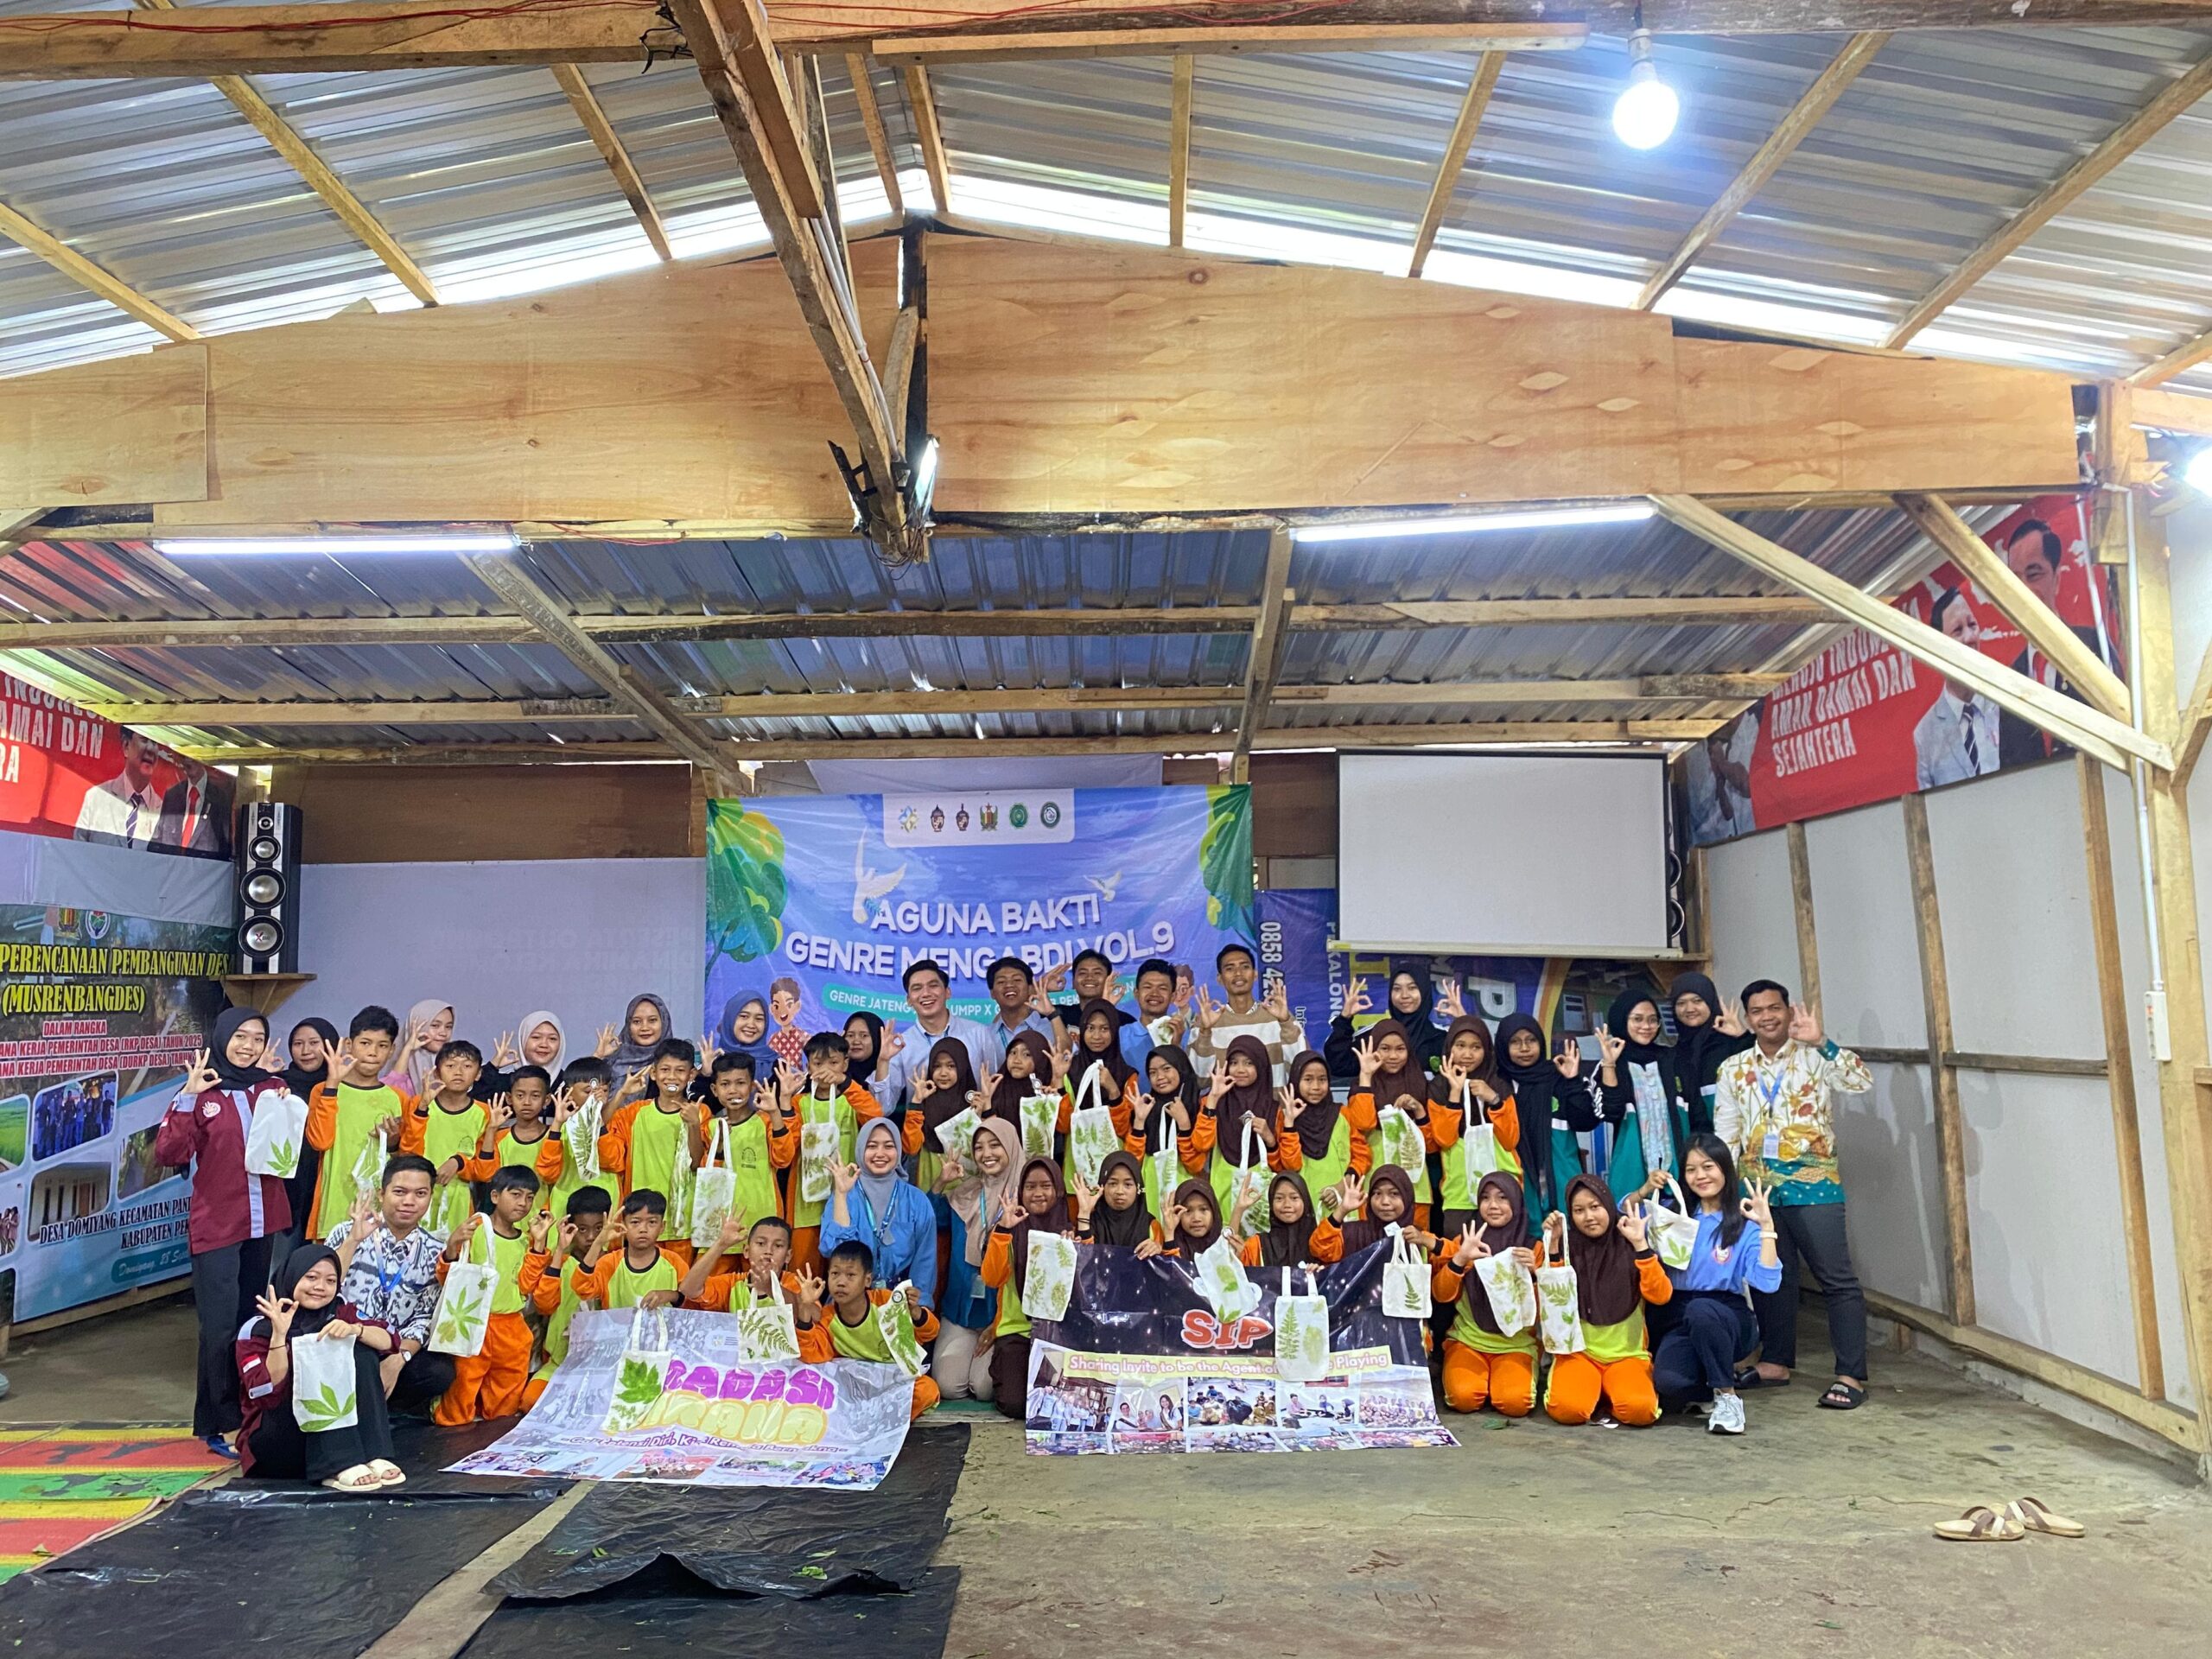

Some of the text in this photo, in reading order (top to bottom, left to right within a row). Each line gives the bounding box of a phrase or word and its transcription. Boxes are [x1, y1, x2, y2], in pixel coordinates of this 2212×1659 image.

[1771, 651, 1916, 740] AMAN DAMAI DAN
[60, 716, 104, 759] DAN
[1772, 718, 1857, 778] SEJAHTERA
[1001, 893, 1101, 933] BAKTI
[0, 944, 109, 976] PERENCANAAN
[112, 948, 206, 977] PEMBANGUNAN
[785, 931, 894, 977] GENRE
[901, 939, 1073, 978] MENGBDI
[1261, 922, 1283, 963] 0858
[3, 984, 146, 1017] (MUSRENBANGDES)
[830, 989, 866, 1006] GENRE
[950, 1003, 983, 1016] UMPP
[984, 1003, 992, 1014] X
[20, 1040, 46, 1057] KERJA
[48, 1039, 99, 1056] PEMERINTAH
[100, 1038, 119, 1052] DESA
[162, 1035, 183, 1049] TAHUN
[184, 1034, 202, 1048] 2025
[43, 1020, 107, 1036] DALAM RANGKA
[17, 1060, 44, 1077] KERJA
[46, 1058, 97, 1075] PEMERINTAH
[99, 1056, 118, 1070] DESA
[40, 1221, 64, 1244] DESA
[67, 1212, 117, 1239] DOMIYANG
[118, 1200, 173, 1227] KECAMATAN
[121, 1223, 172, 1249] KABUPATEN
[1182, 1309, 1274, 1349] SIP
[1070, 1354, 1121, 1375] Sharing
[1160, 1361, 1175, 1373] to
[1177, 1360, 1194, 1373] be
[1198, 1360, 1219, 1373] the
[1222, 1361, 1262, 1375] Agent
[1336, 1353, 1388, 1370] Playing
